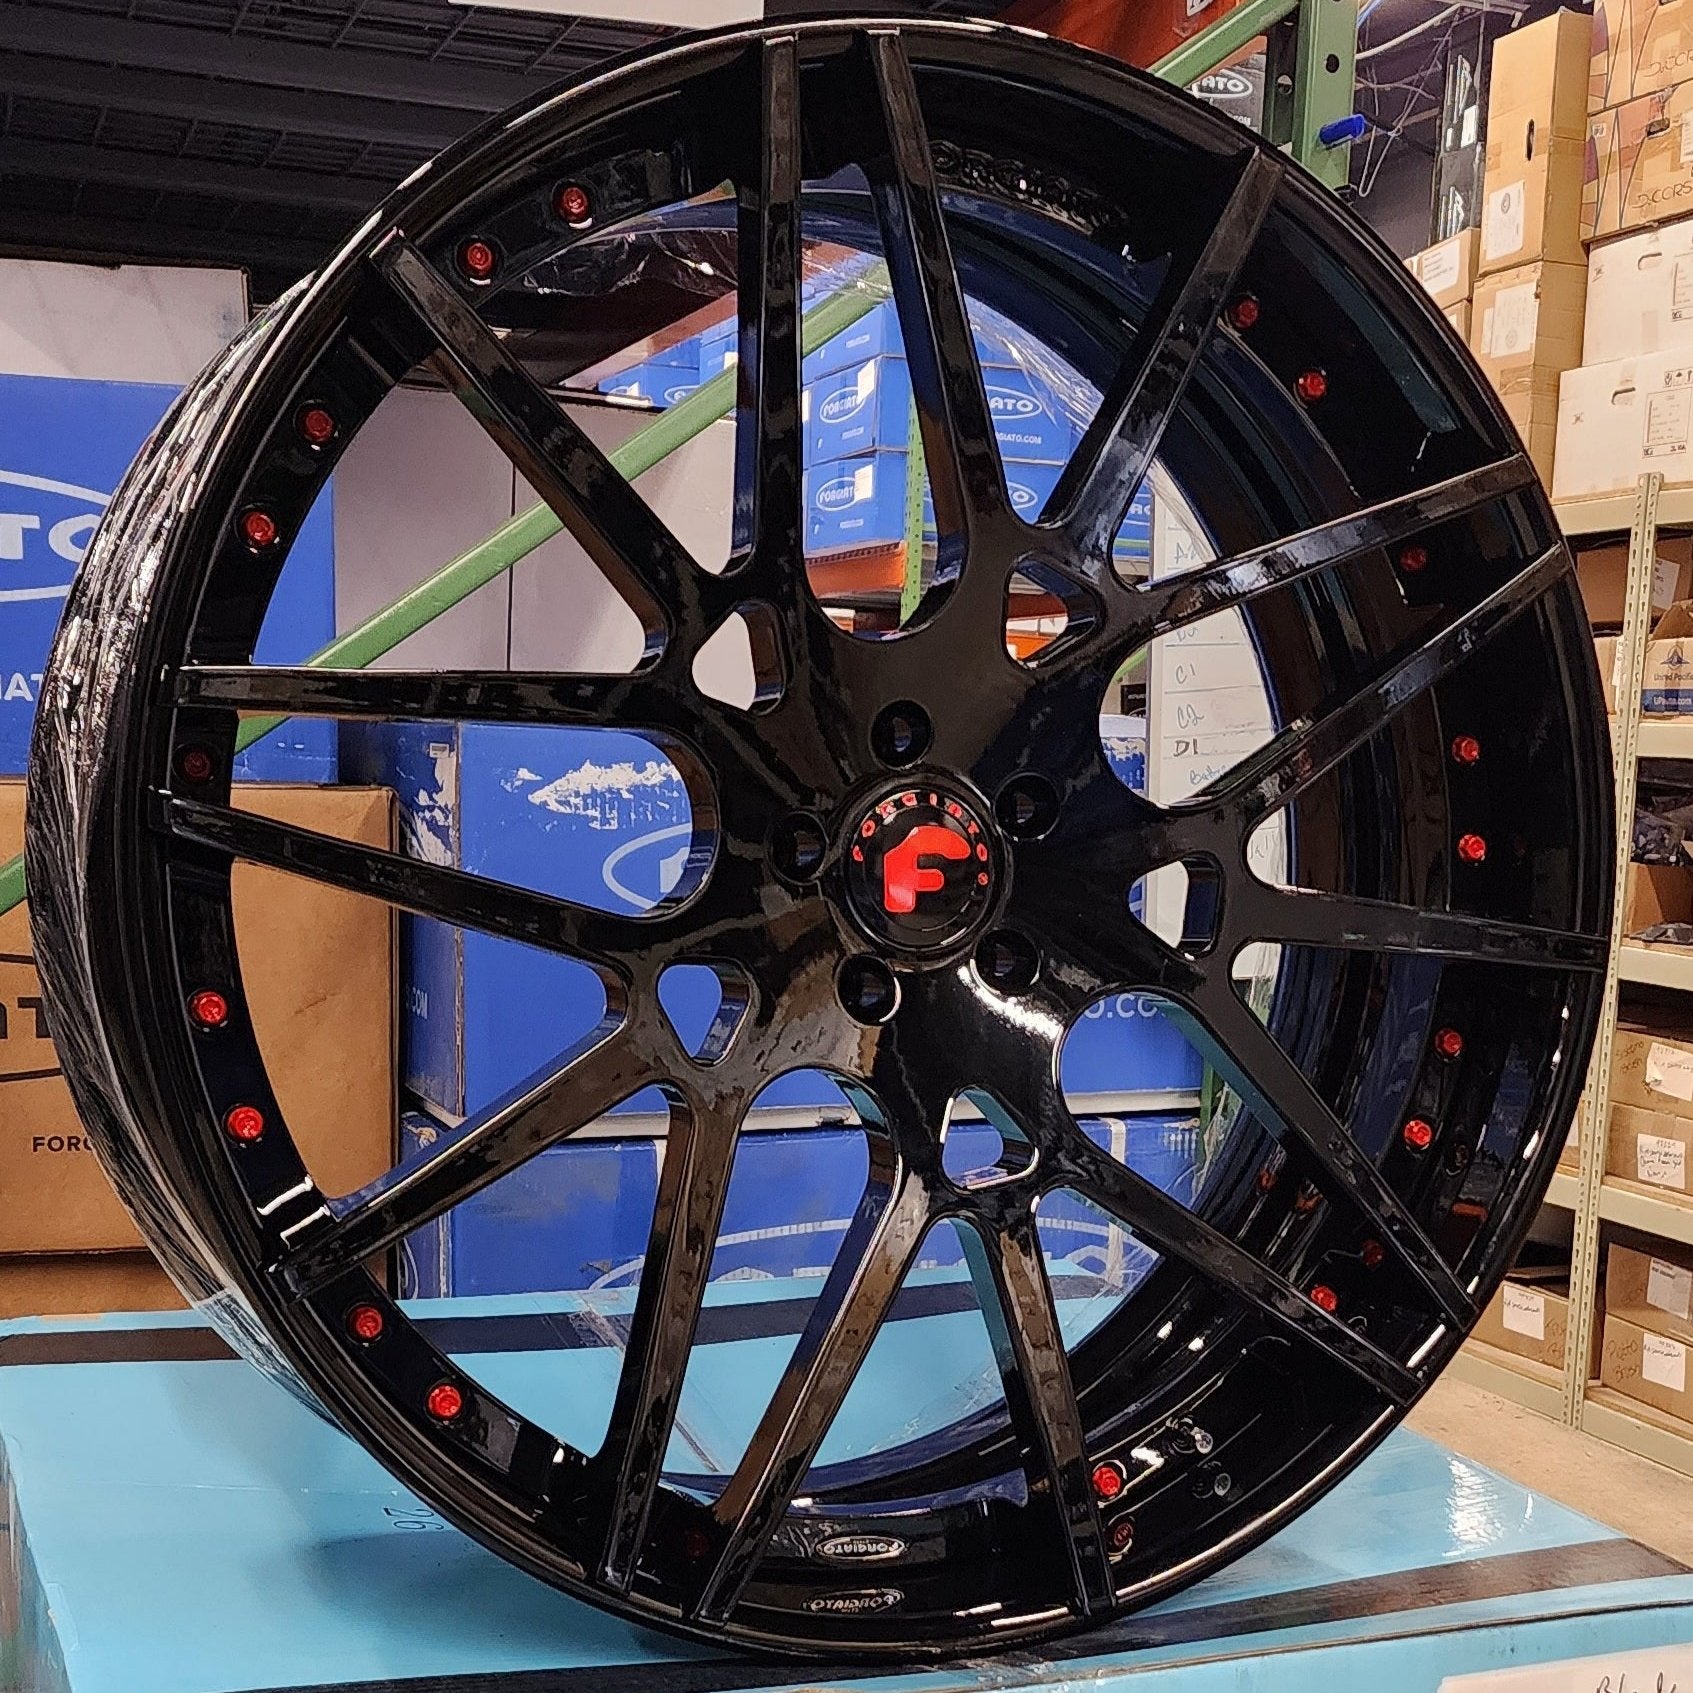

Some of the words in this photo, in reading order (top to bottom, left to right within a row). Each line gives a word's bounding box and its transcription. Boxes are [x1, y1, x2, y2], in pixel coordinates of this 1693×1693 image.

[822, 394, 860, 417] FORGIAT
[996, 432, 1042, 444] GIATO.COM
[819, 486, 855, 504] FORGIAT
